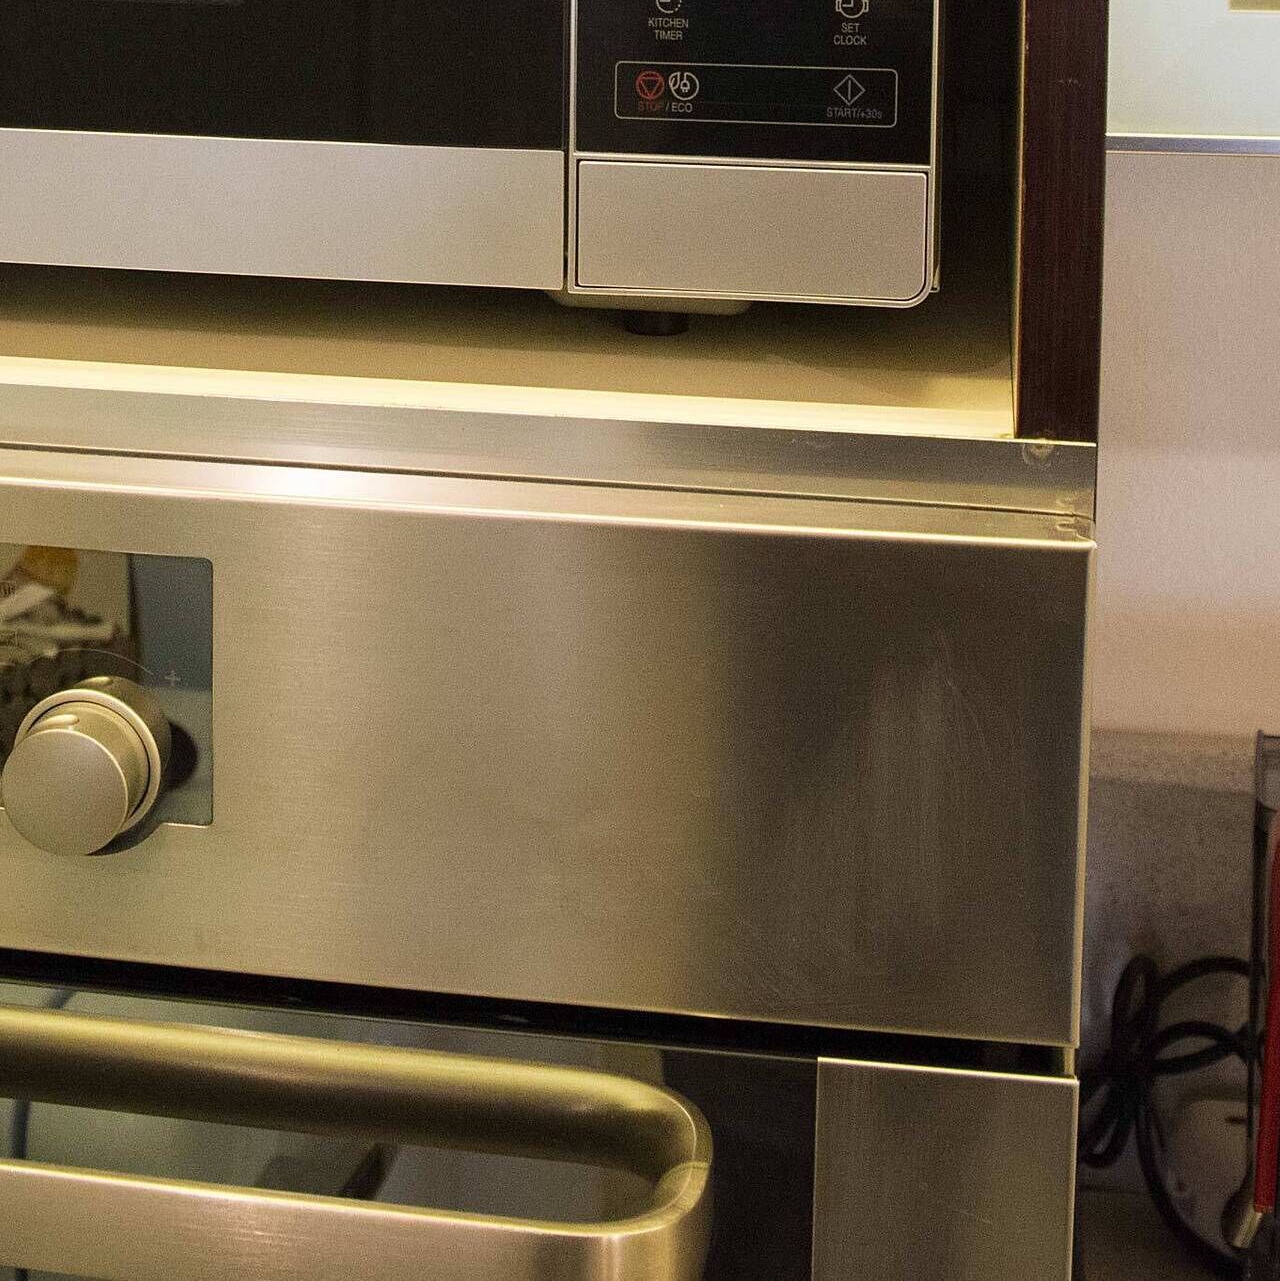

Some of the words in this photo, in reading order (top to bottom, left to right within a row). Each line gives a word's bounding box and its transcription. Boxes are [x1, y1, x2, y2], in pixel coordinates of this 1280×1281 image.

[648, 17, 689, 28] KITCHEN
[841, 22, 861, 33] SET
[654, 29, 683, 40] TIMER
[833, 34, 867, 46] CLOCK
